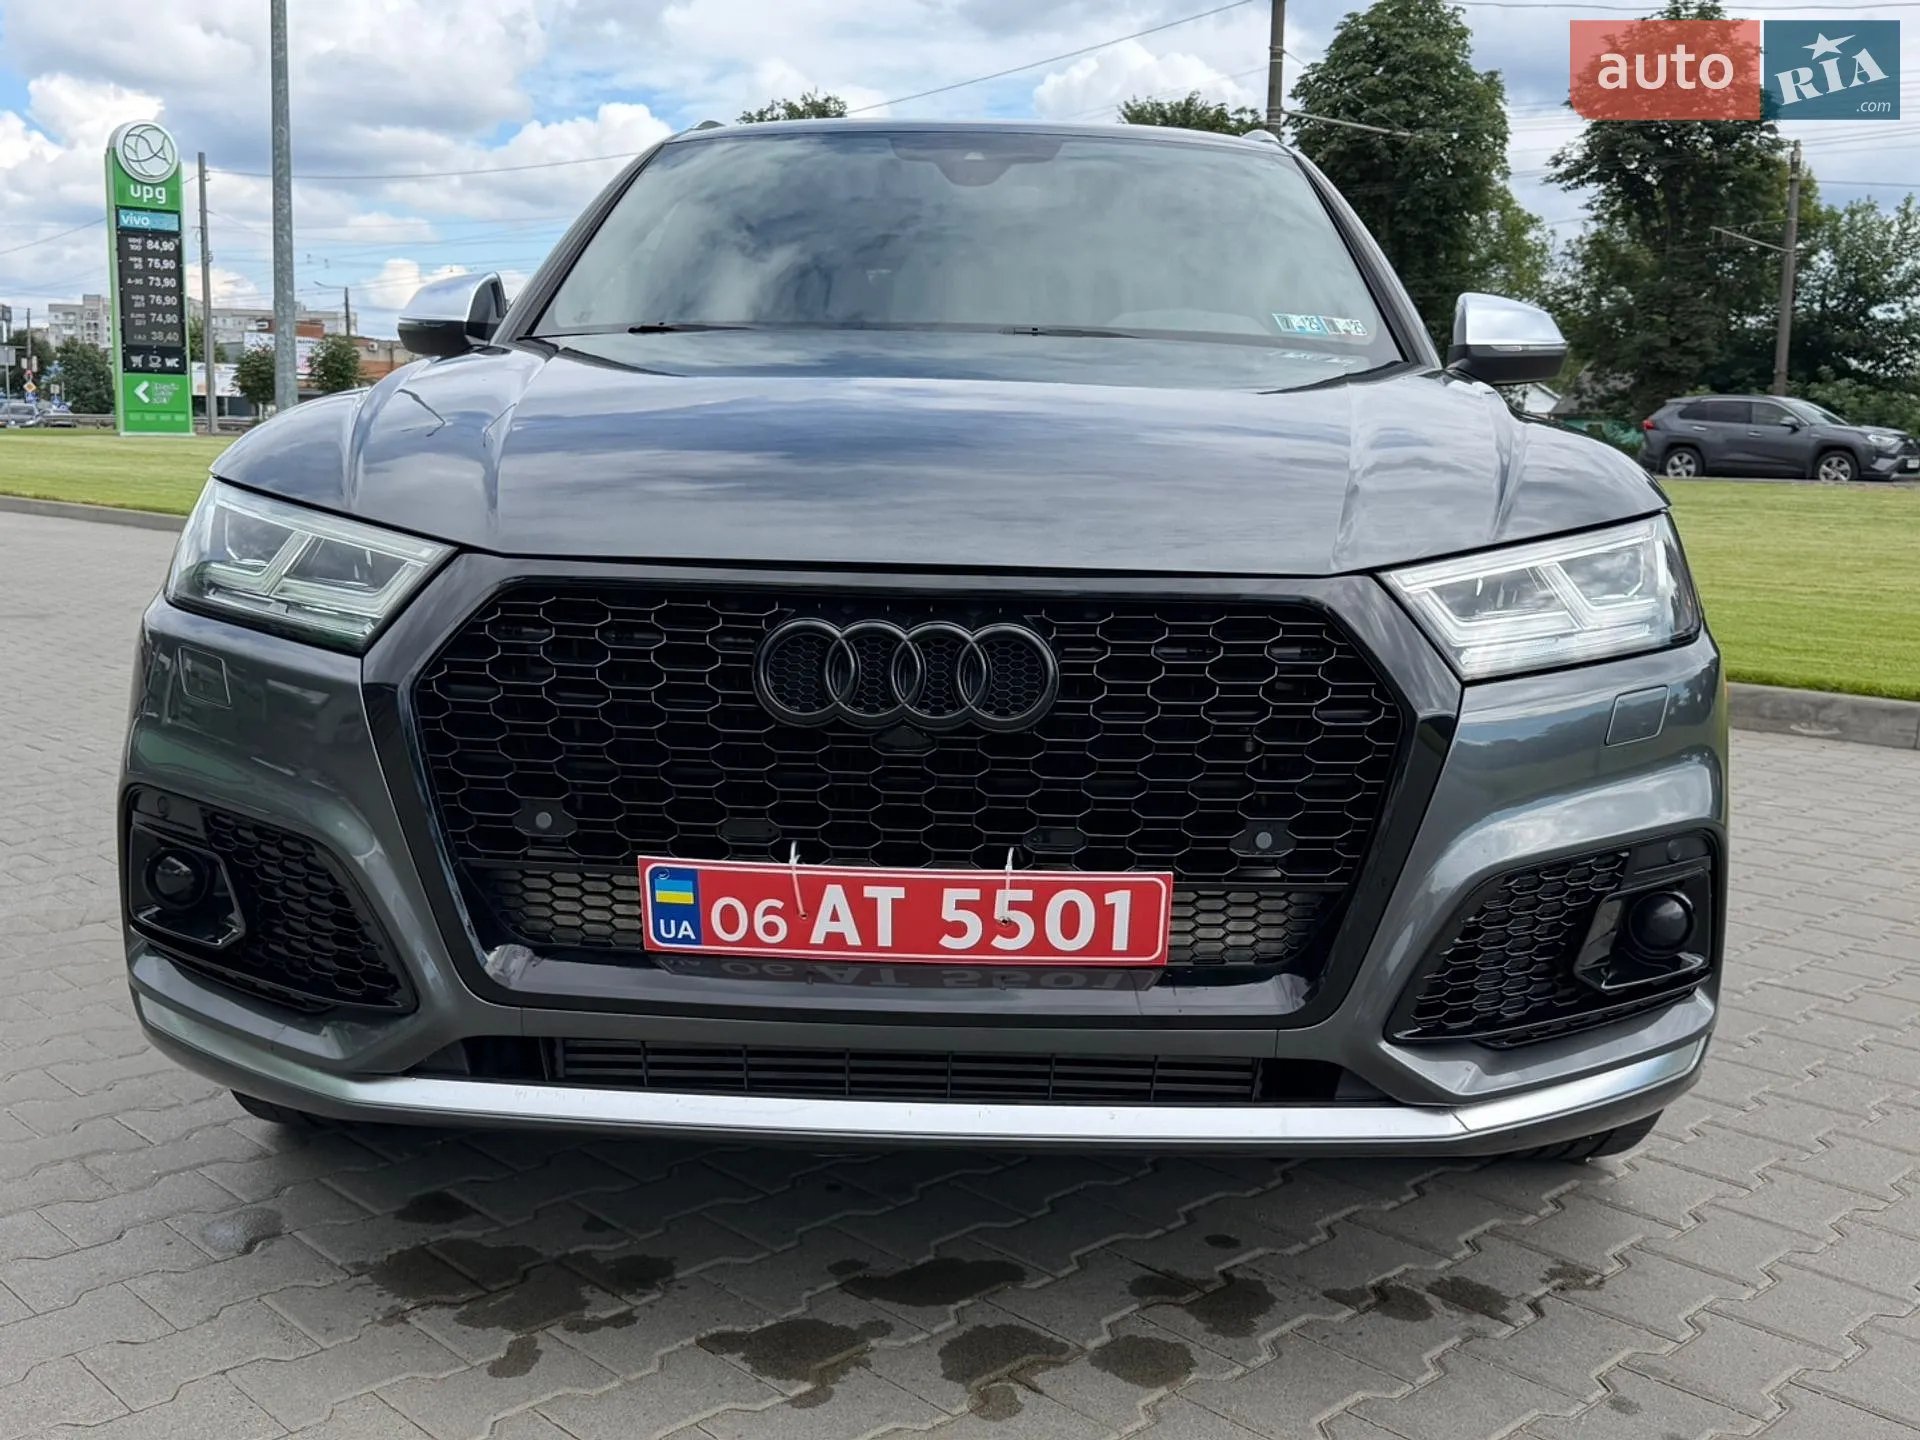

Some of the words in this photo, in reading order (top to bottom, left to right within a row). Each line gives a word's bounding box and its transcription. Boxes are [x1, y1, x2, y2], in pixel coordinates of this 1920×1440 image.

[130, 184, 166, 204] upg
[121, 212, 150, 226] vivo
[165, 357, 180, 368] WC
[710, 896, 789, 944] 06
[809, 884, 905, 948] AT
[938, 887, 1131, 952] 5501
[659, 917, 696, 941] UA
